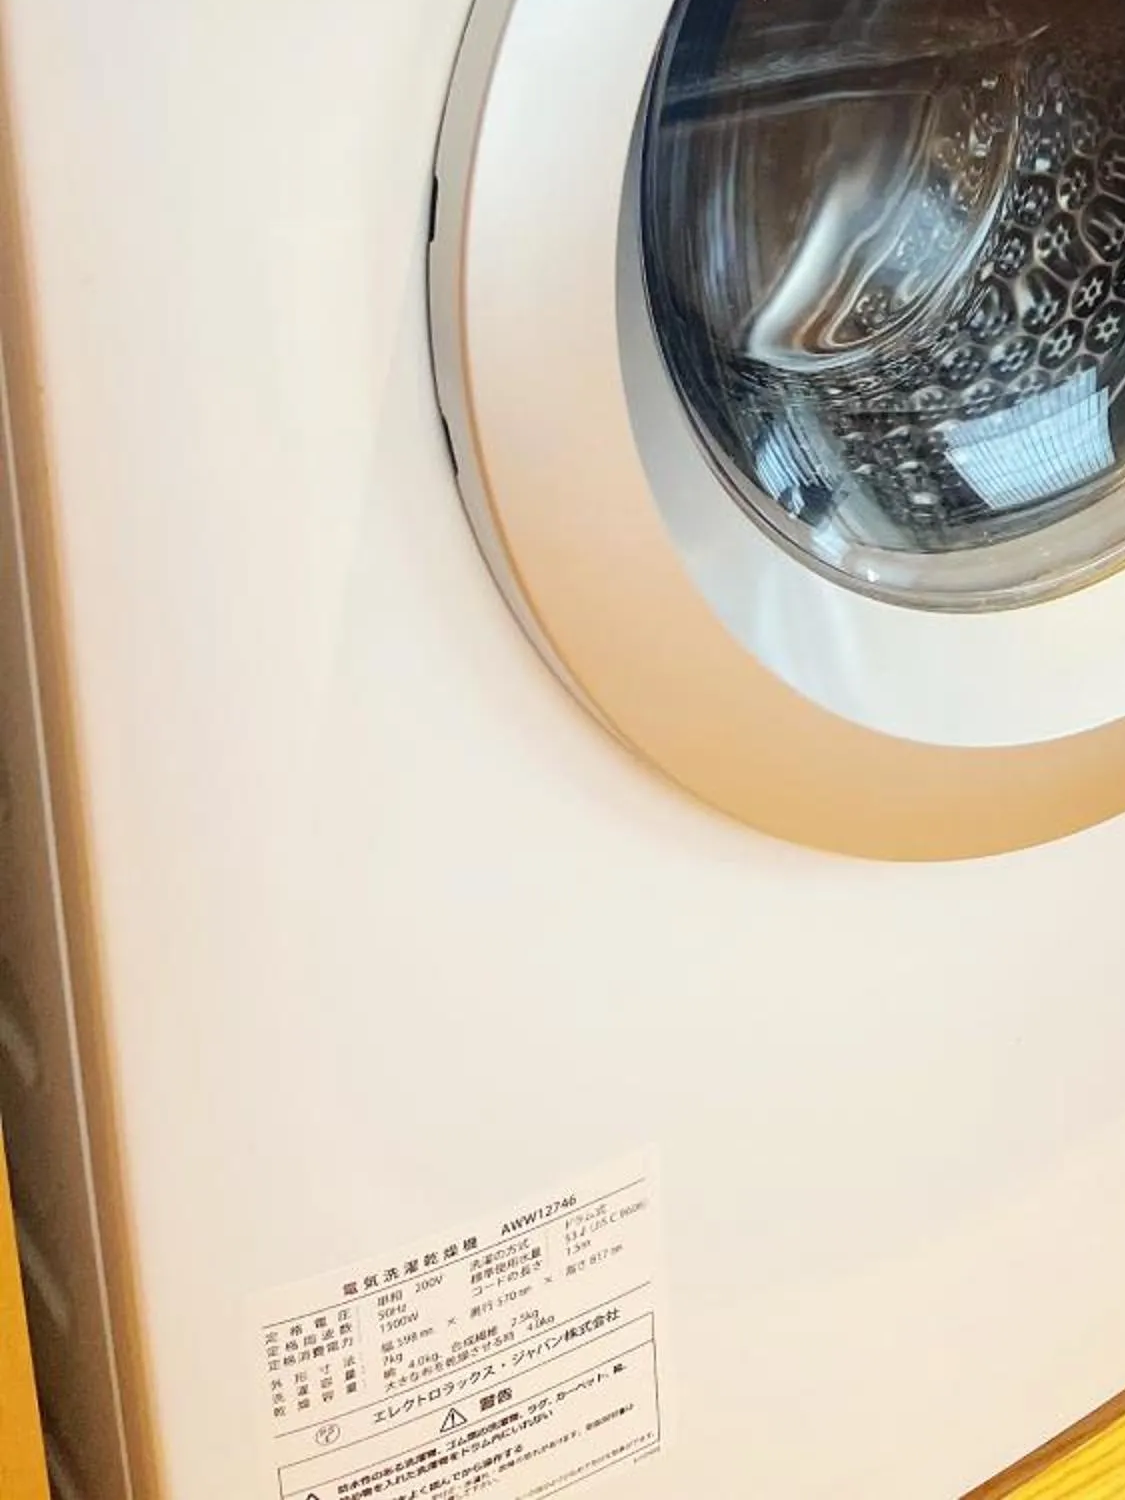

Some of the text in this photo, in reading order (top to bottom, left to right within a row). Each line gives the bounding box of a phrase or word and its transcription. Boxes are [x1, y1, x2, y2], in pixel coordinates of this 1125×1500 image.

[500, 1192, 577, 1236] AWW12746
[377, 1303, 408, 1322] 50Hz
[373, 1306, 621, 1425] エレクトロラックス・ジャパン株式会社
[382, 1352, 403, 1370] 7kg
